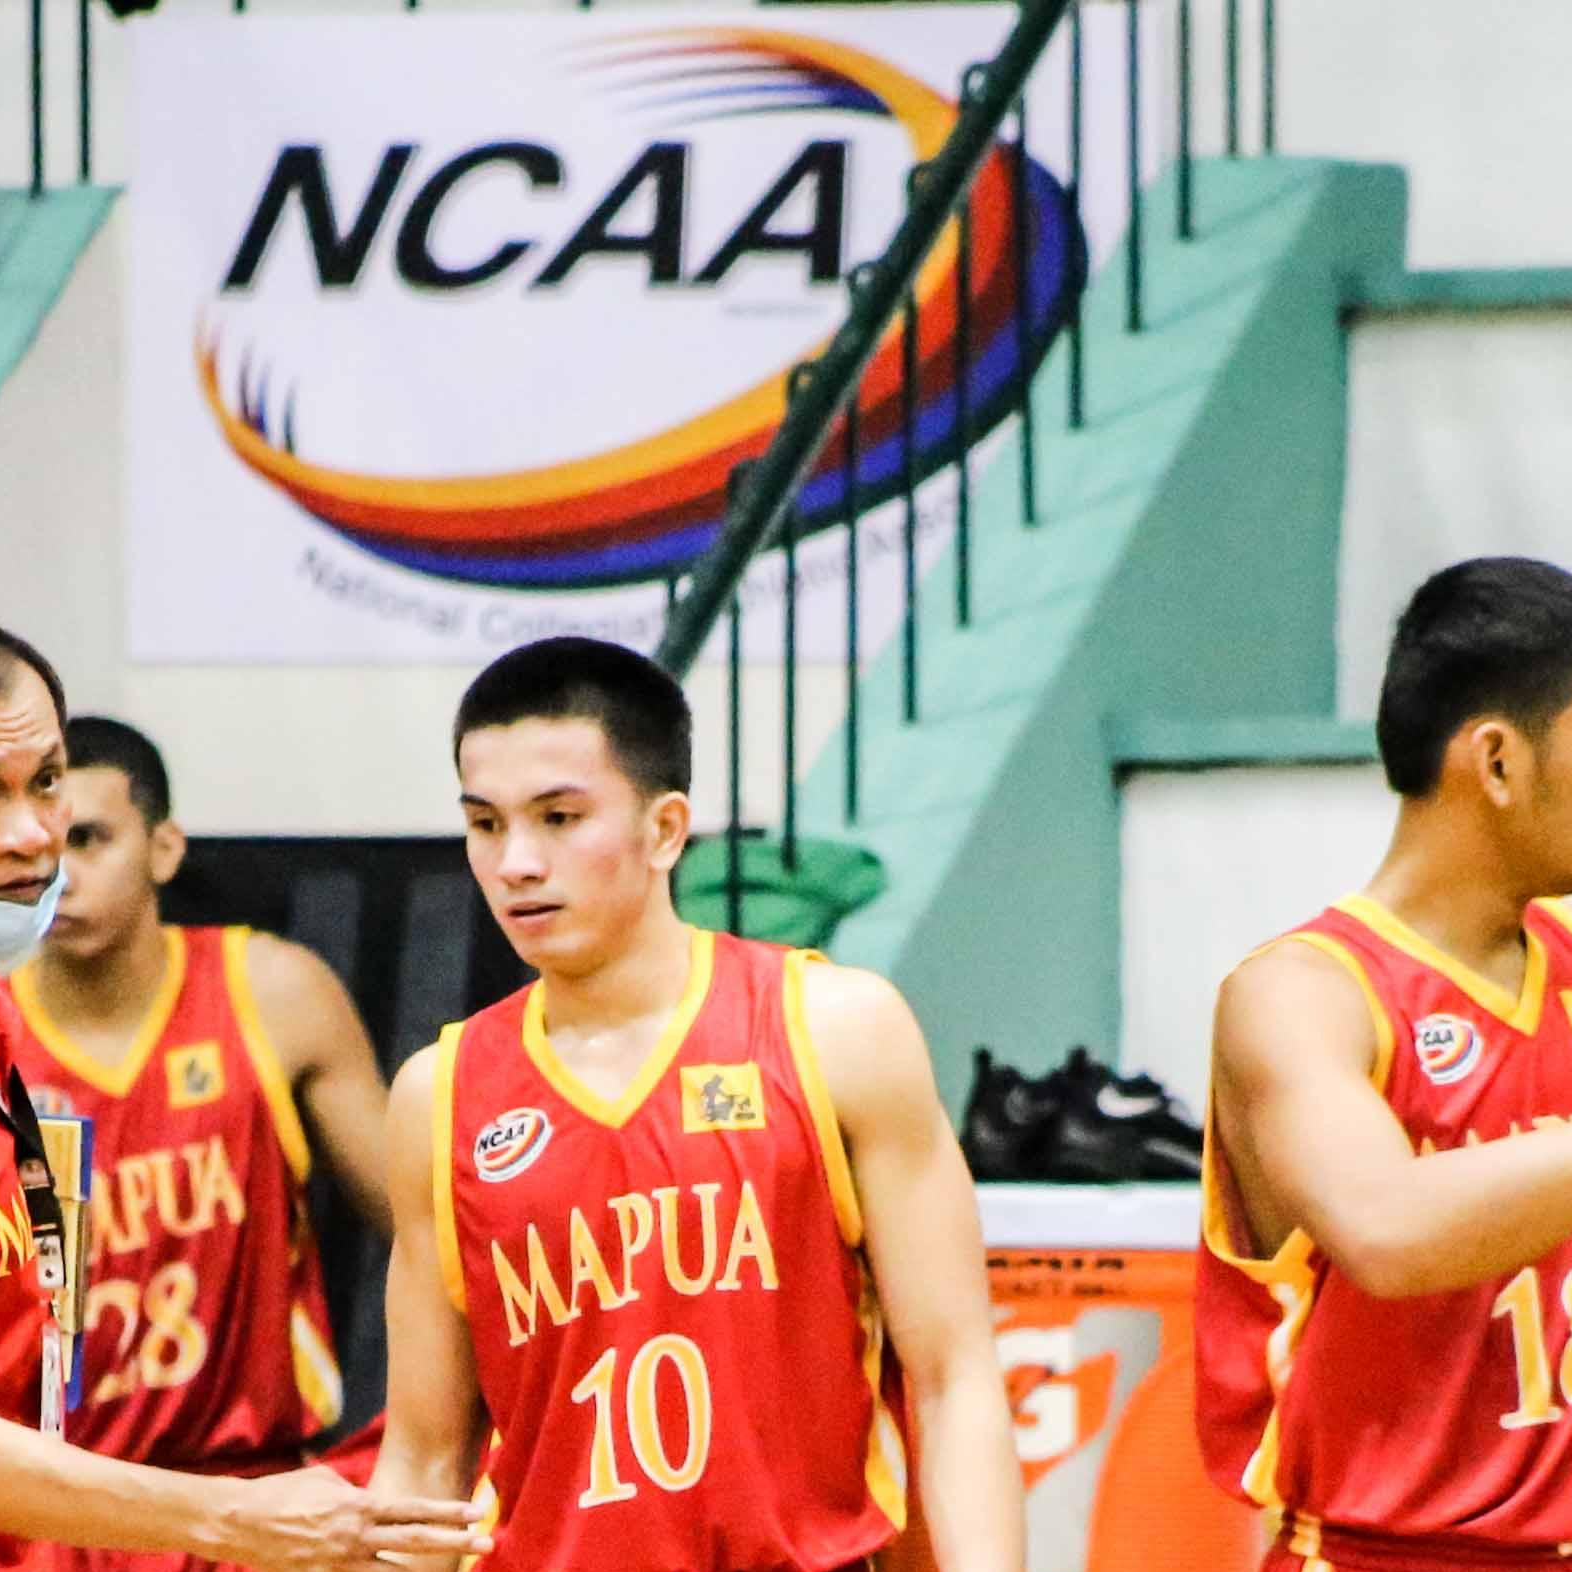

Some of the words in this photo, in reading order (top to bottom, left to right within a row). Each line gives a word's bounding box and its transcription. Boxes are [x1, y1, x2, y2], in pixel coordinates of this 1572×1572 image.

[226, 140, 853, 290] NCAA
[89, 1134, 246, 1263] APUA
[477, 1122, 526, 1155] NCAA
[84, 1261, 209, 1405] 28
[492, 1180, 780, 1348] MAPUA
[570, 1333, 712, 1509] 10
